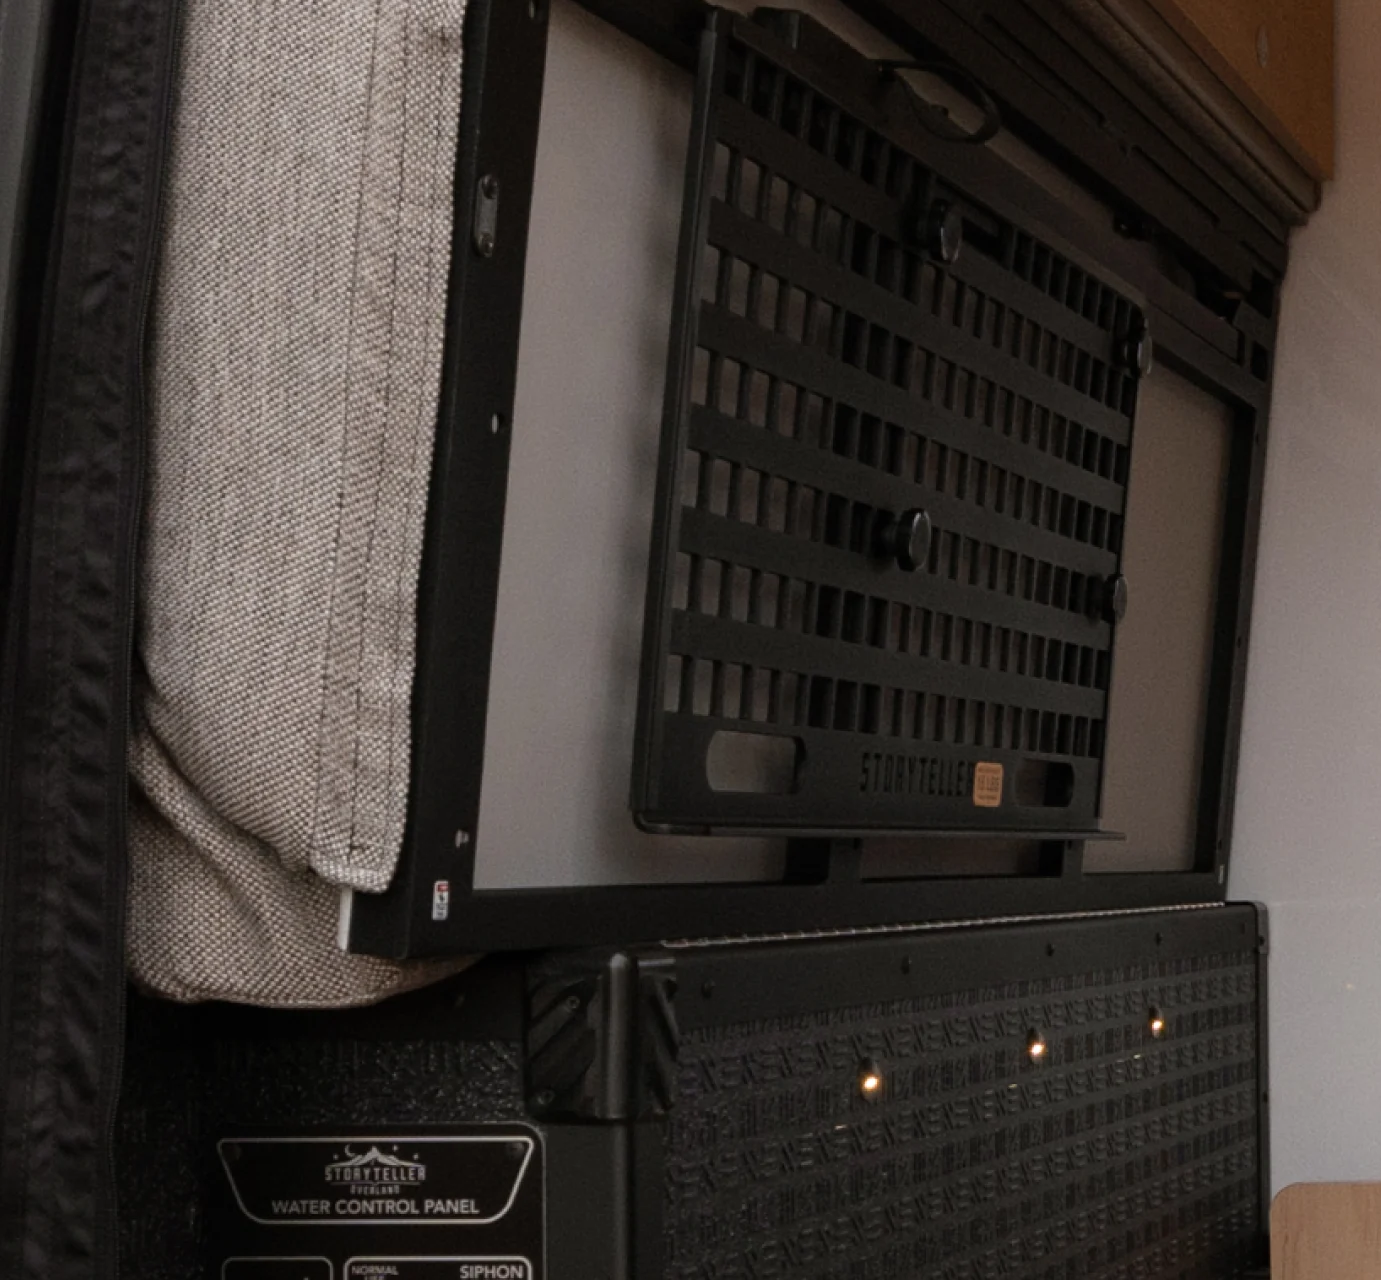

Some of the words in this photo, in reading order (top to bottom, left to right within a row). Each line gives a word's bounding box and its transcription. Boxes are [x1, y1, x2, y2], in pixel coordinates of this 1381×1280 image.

[324, 1165, 427, 1182] STORYTELLER
[272, 1199, 331, 1215] WATER
[335, 1199, 419, 1215] CONTROL
[424, 1199, 480, 1215] PANEL
[351, 1265, 399, 1276] NORMAL
[459, 1265, 523, 1280] SIPHON
